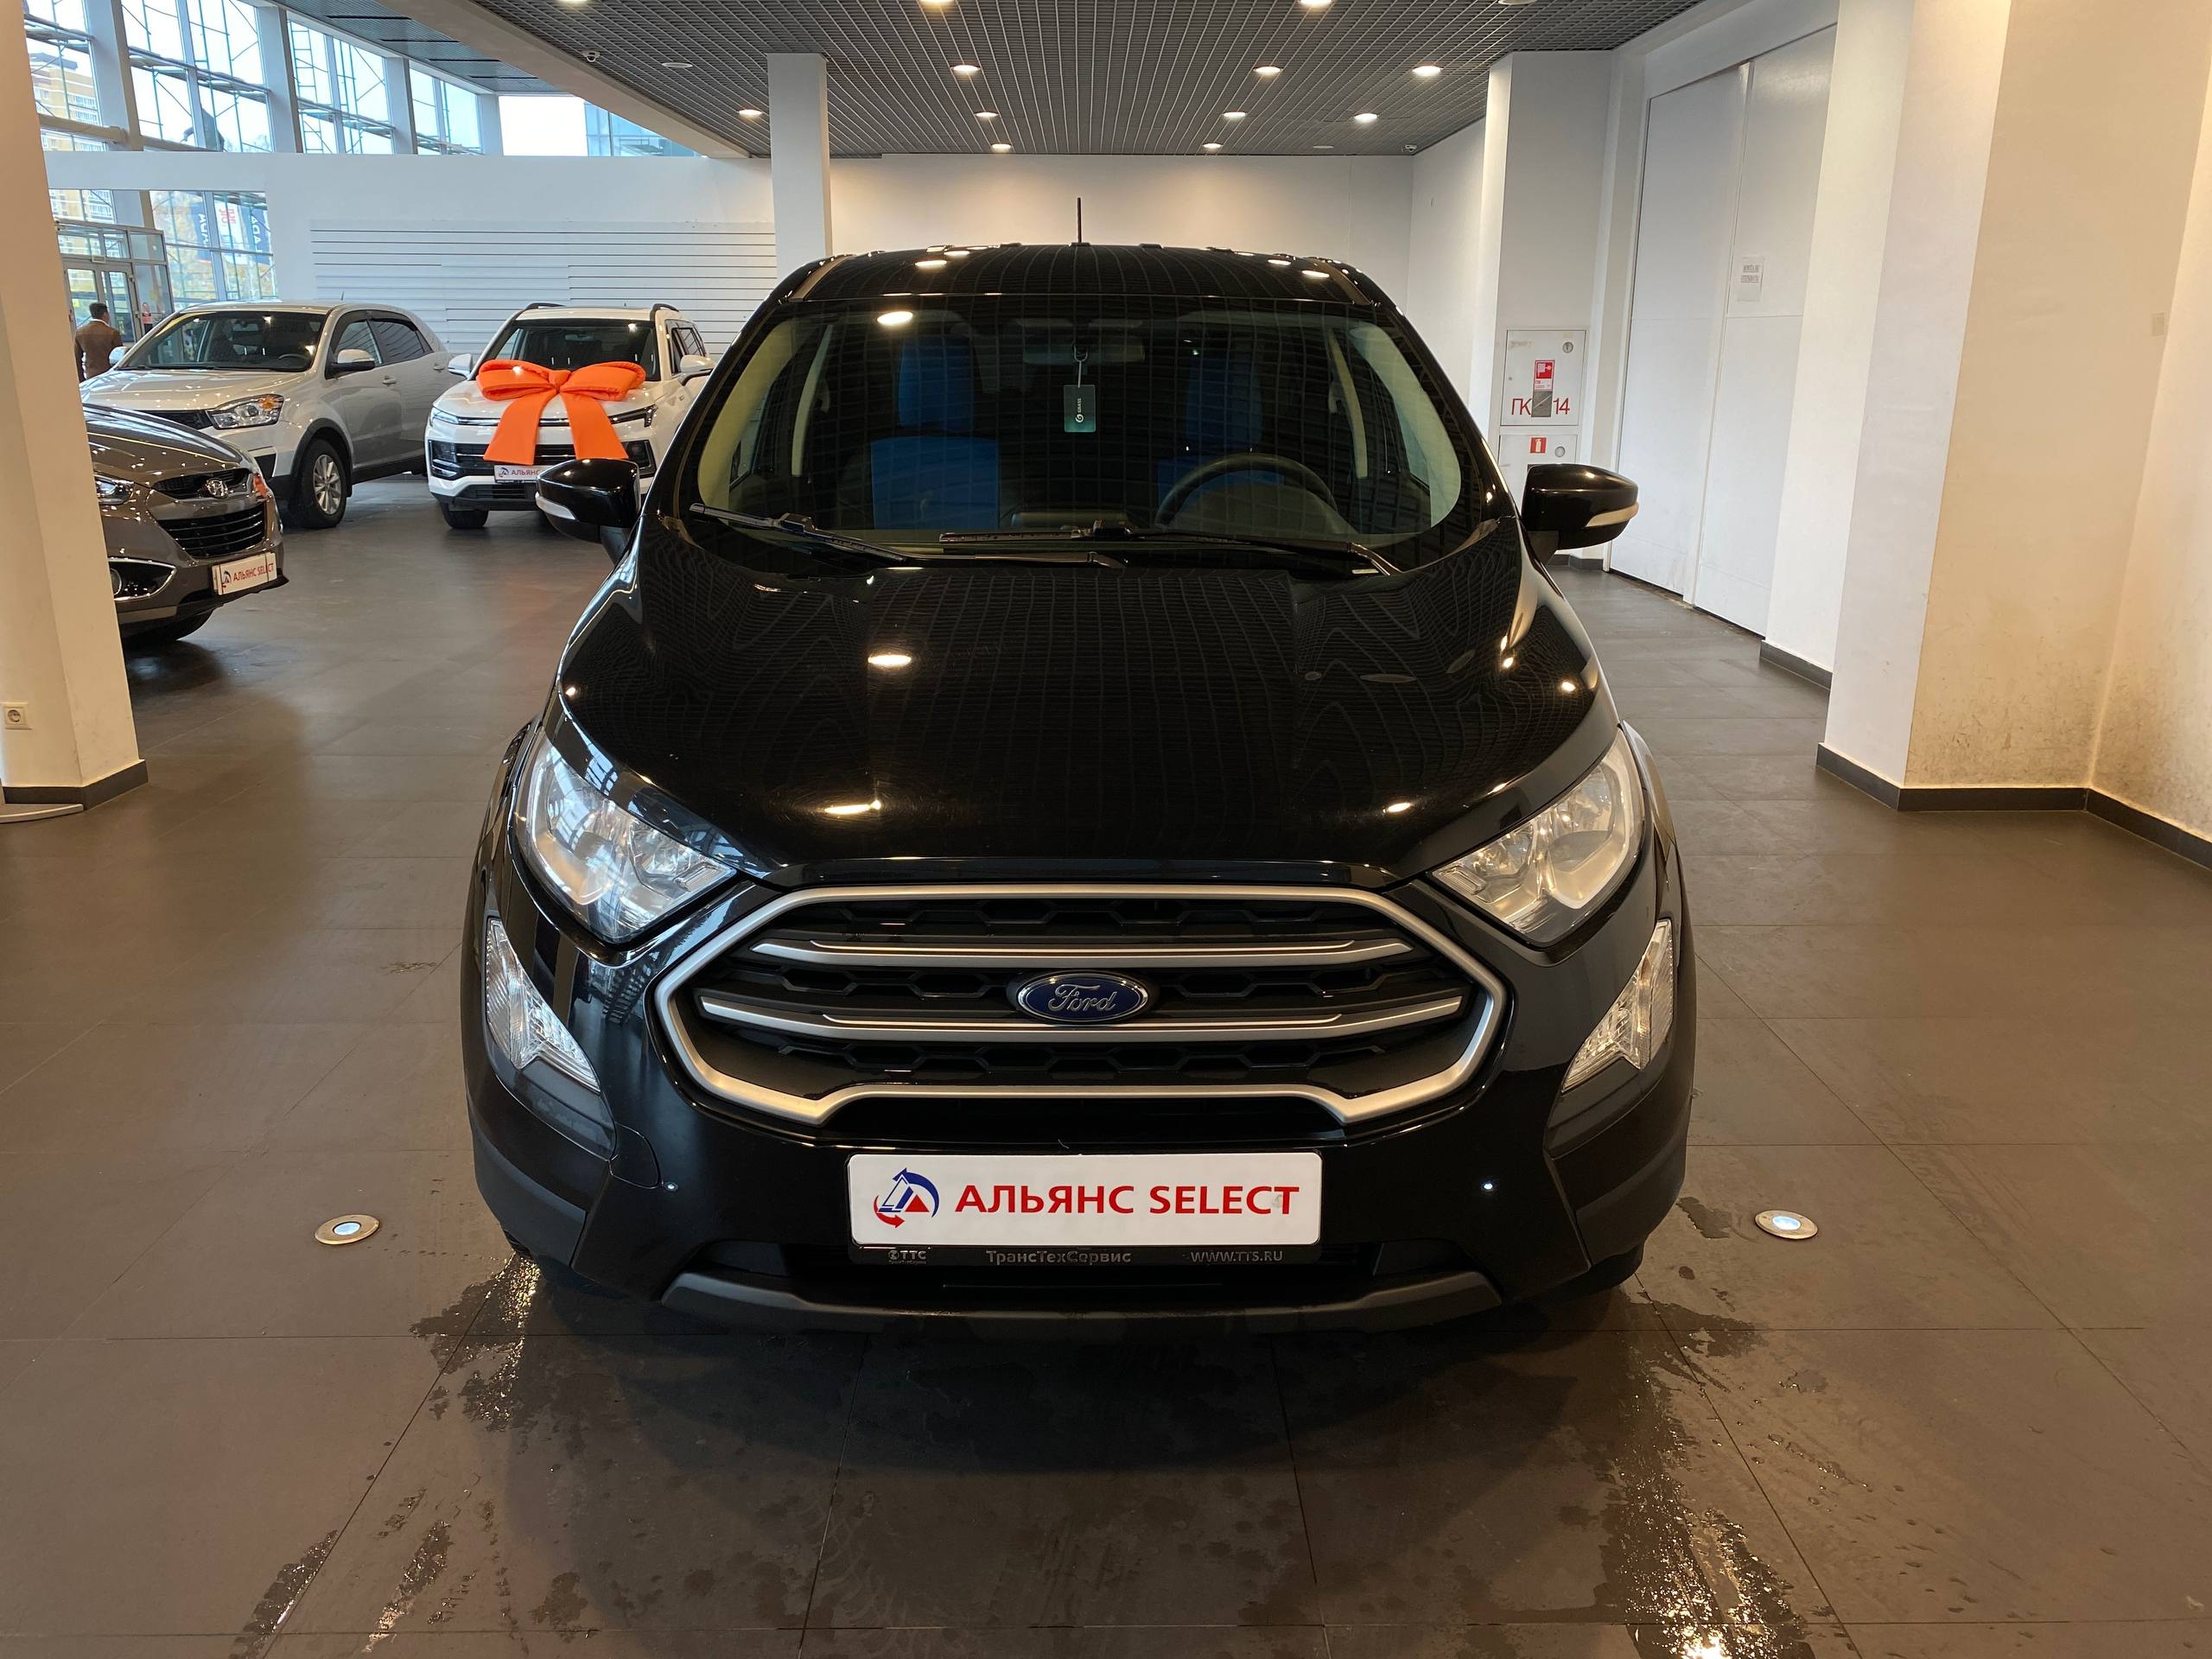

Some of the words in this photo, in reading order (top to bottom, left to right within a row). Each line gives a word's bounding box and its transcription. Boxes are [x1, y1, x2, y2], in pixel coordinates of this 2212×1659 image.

[1511, 397, 1532, 416] ПК
[1553, 397, 1570, 415] 14
[233, 566, 257, 582] АЛЬЯНС
[1047, 984, 1118, 1012] Ford
[955, 1185, 1135, 1214] АЛЬЯНС
[1149, 1185, 1300, 1215] SELECT
[986, 1250, 1133, 1266] ТрансТехСервис
[1190, 1250, 1283, 1262] WWW.TTS.RU
